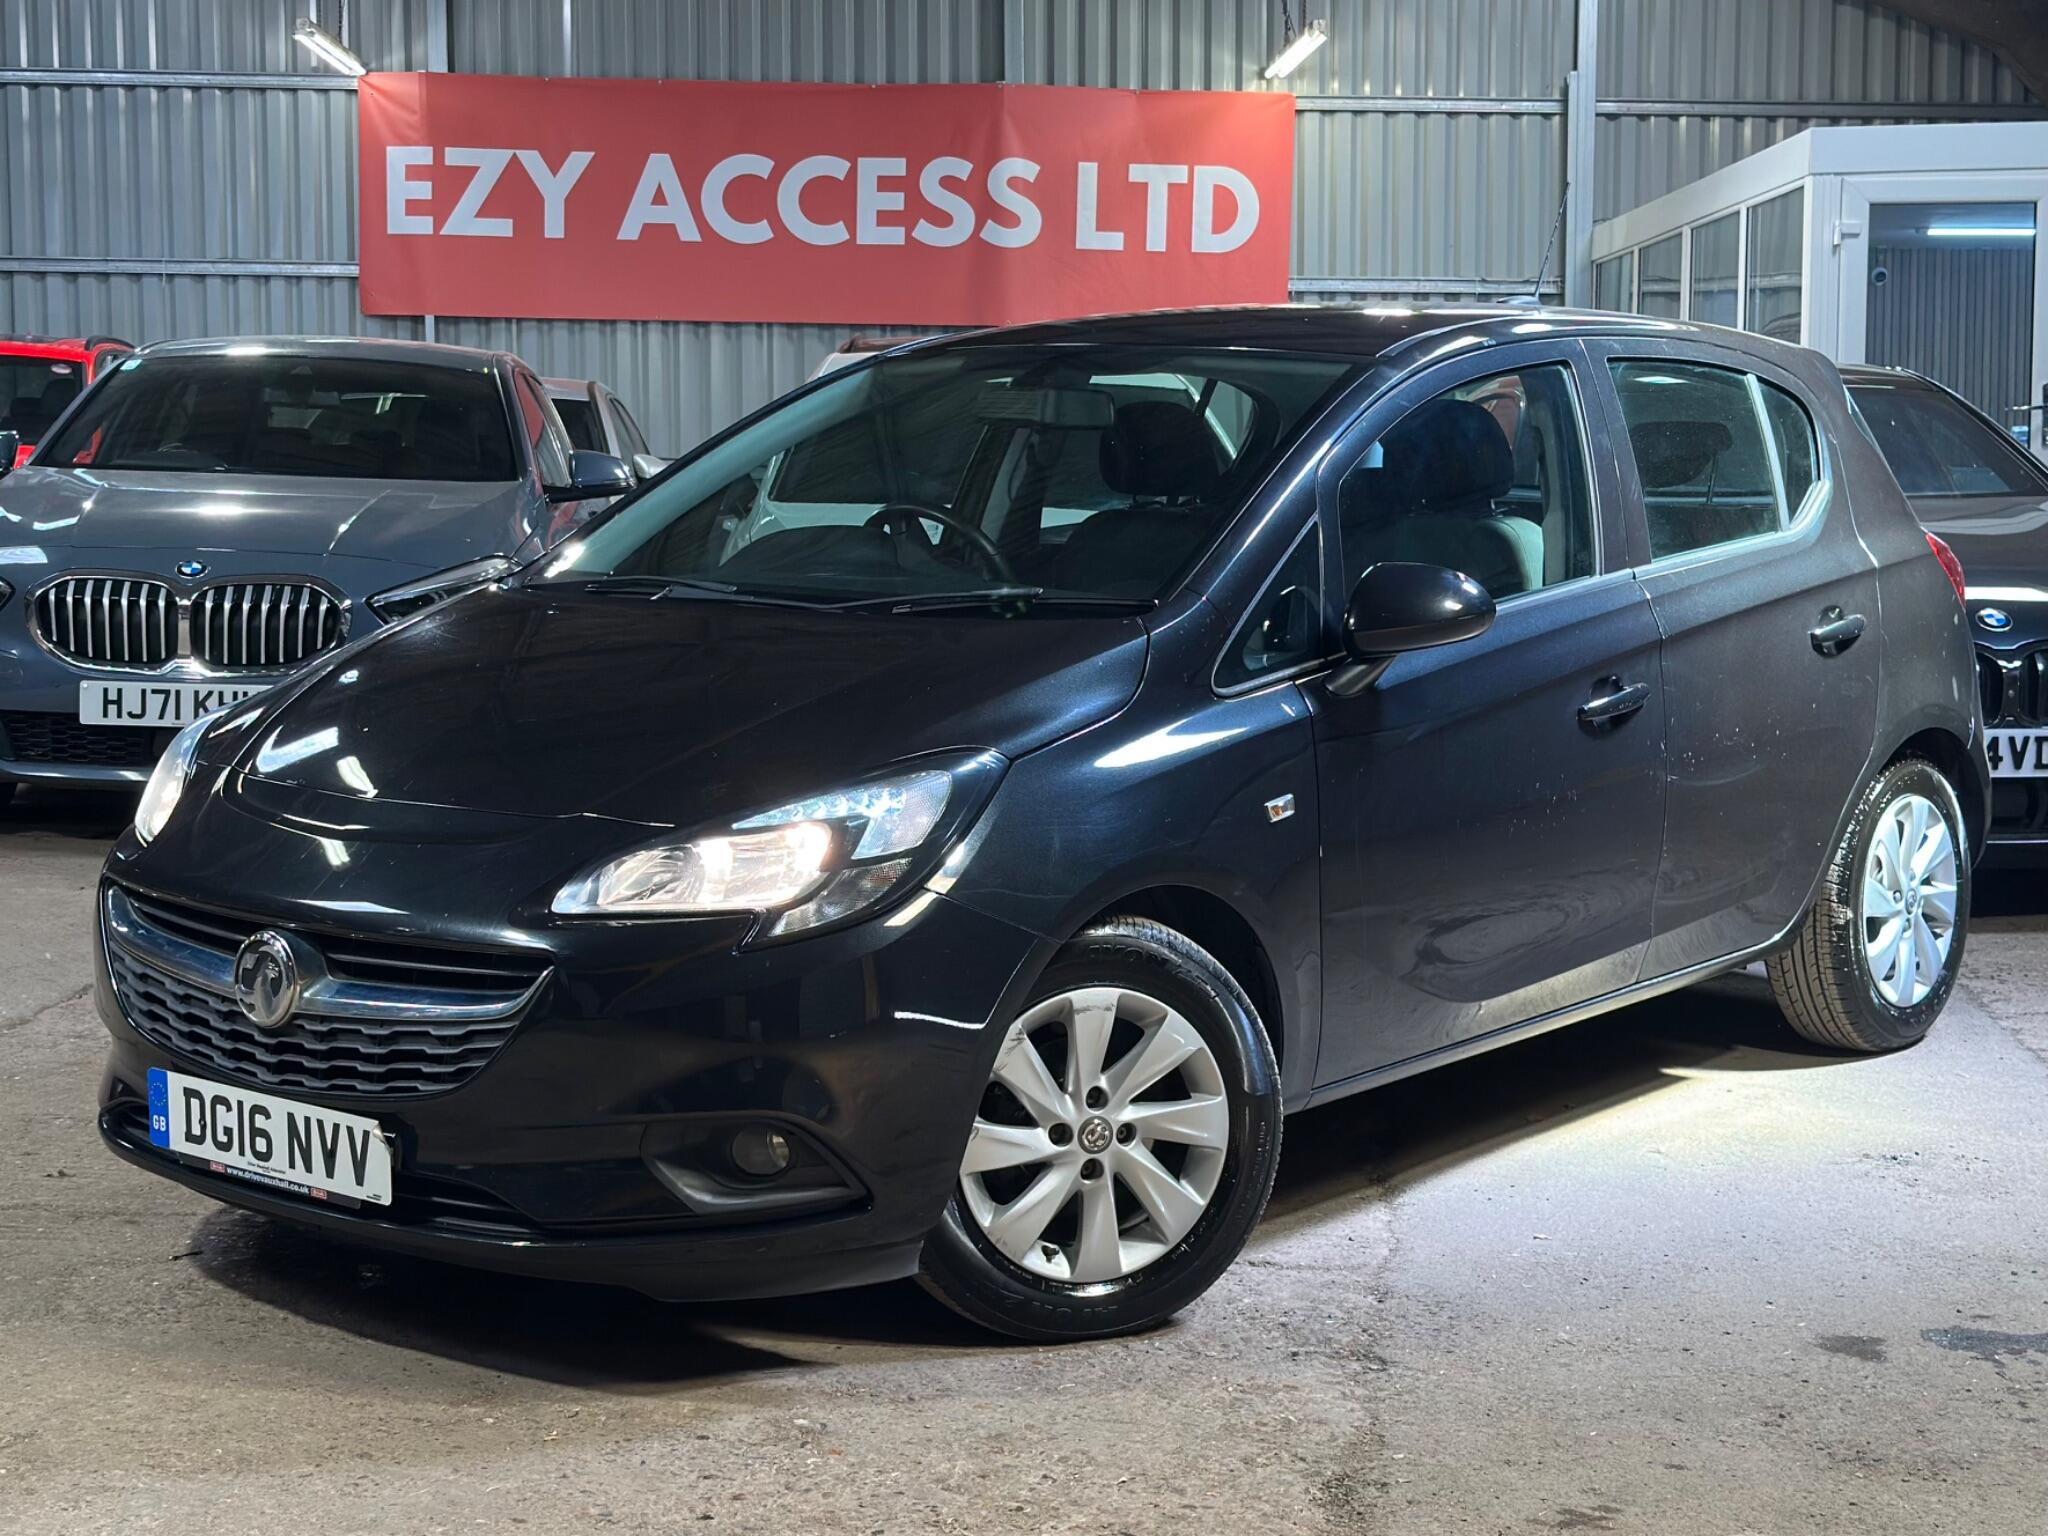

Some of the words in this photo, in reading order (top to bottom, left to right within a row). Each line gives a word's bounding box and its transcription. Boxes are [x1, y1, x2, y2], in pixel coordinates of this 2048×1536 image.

[385, 145, 595, 239] EZY
[616, 153, 1043, 248] ACCESS
[1075, 162, 1260, 254] LTD
[102, 687, 181, 721] HJ71
[153, 1114, 167, 1132] GB
[182, 1086, 273, 1162] DG16
[287, 1111, 370, 1187] NVV
